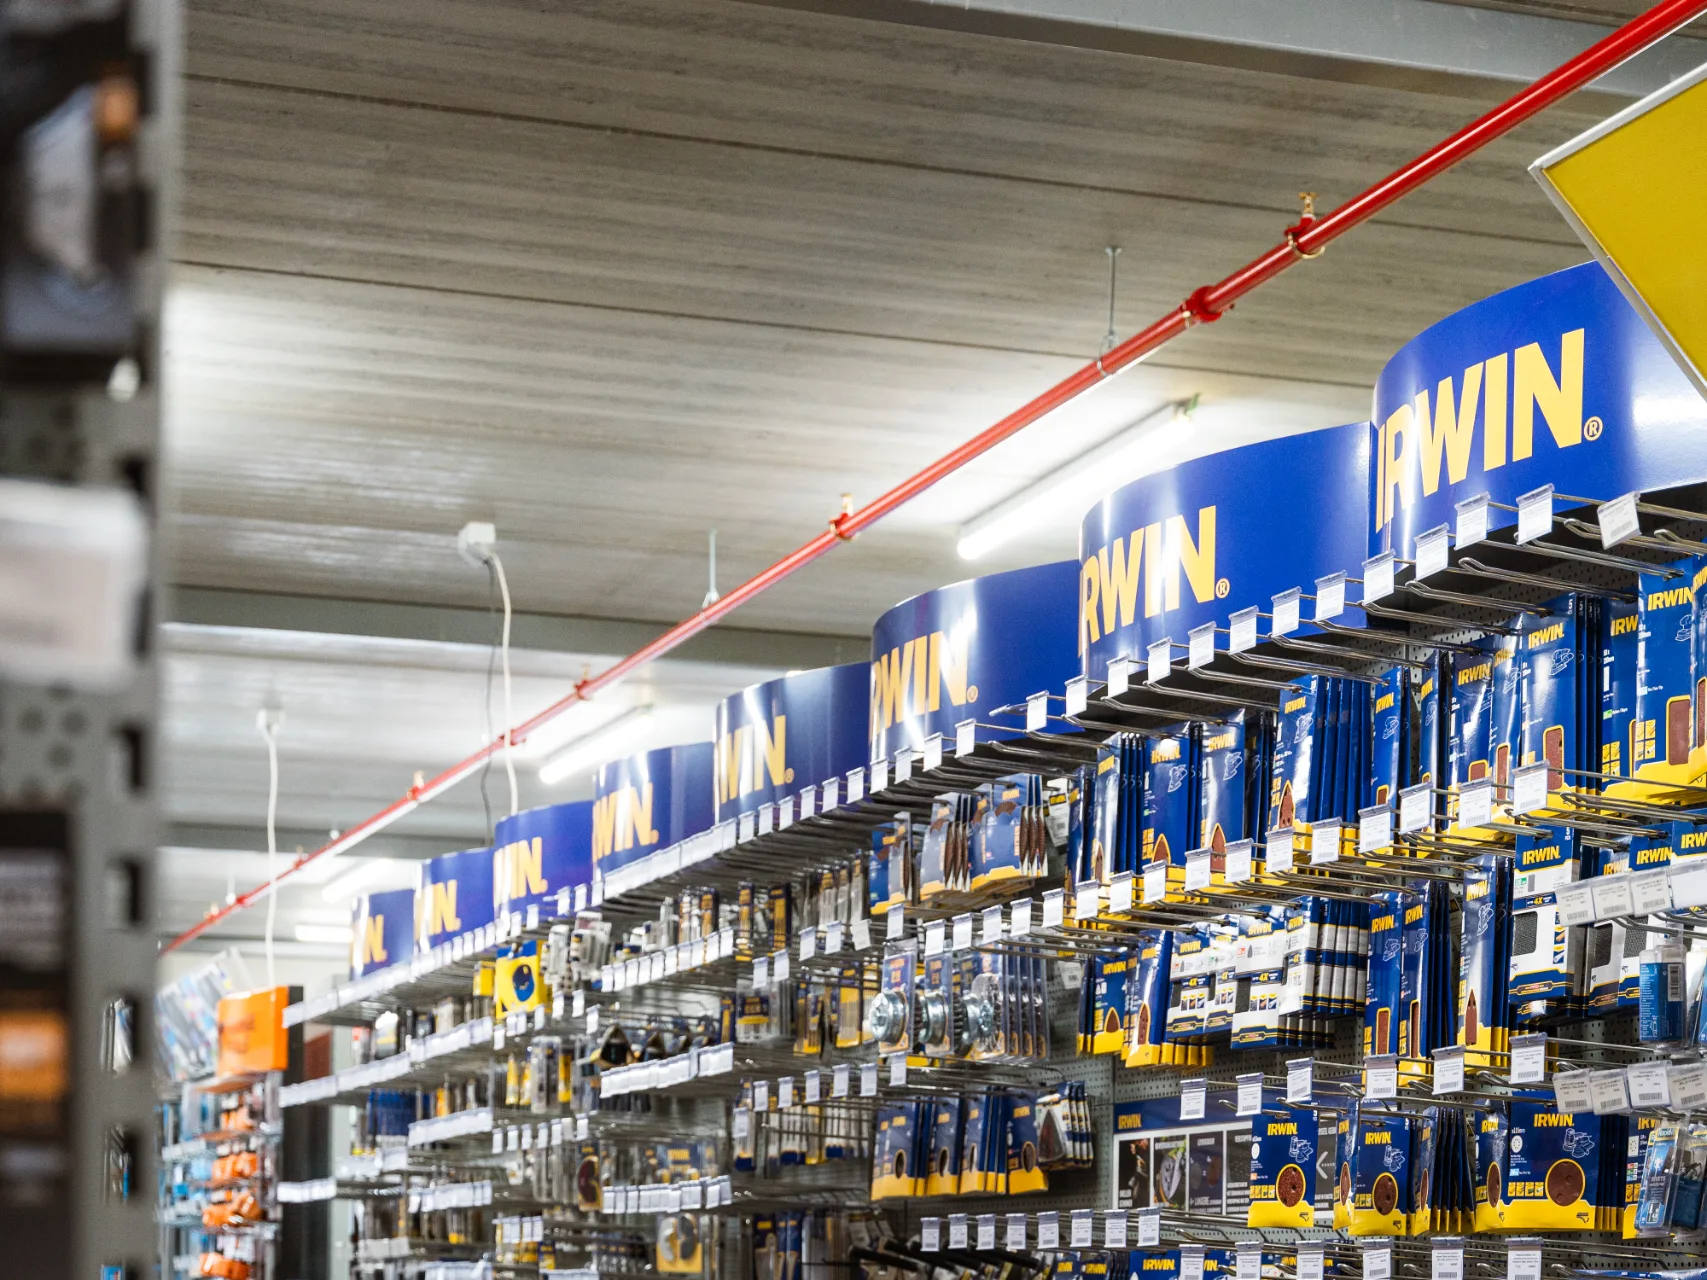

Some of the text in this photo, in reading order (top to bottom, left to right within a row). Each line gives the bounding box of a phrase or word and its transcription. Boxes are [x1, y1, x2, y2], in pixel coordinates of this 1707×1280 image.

[1529, 621, 1564, 649] IRWIN
[1611, 614, 1638, 637] IRW
[1458, 662, 1492, 686] IRWIN
[1522, 845, 1560, 866] IRWIN
[1636, 847, 1672, 865] IRWIN
[1372, 914, 1395, 934] IRWIN
[1267, 1122, 1298, 1136] IRWIN
[1533, 1113, 1574, 1127] IRWIN
[1365, 1131, 1392, 1145] IRWIN
[1143, 1259, 1175, 1271] IRWIN
